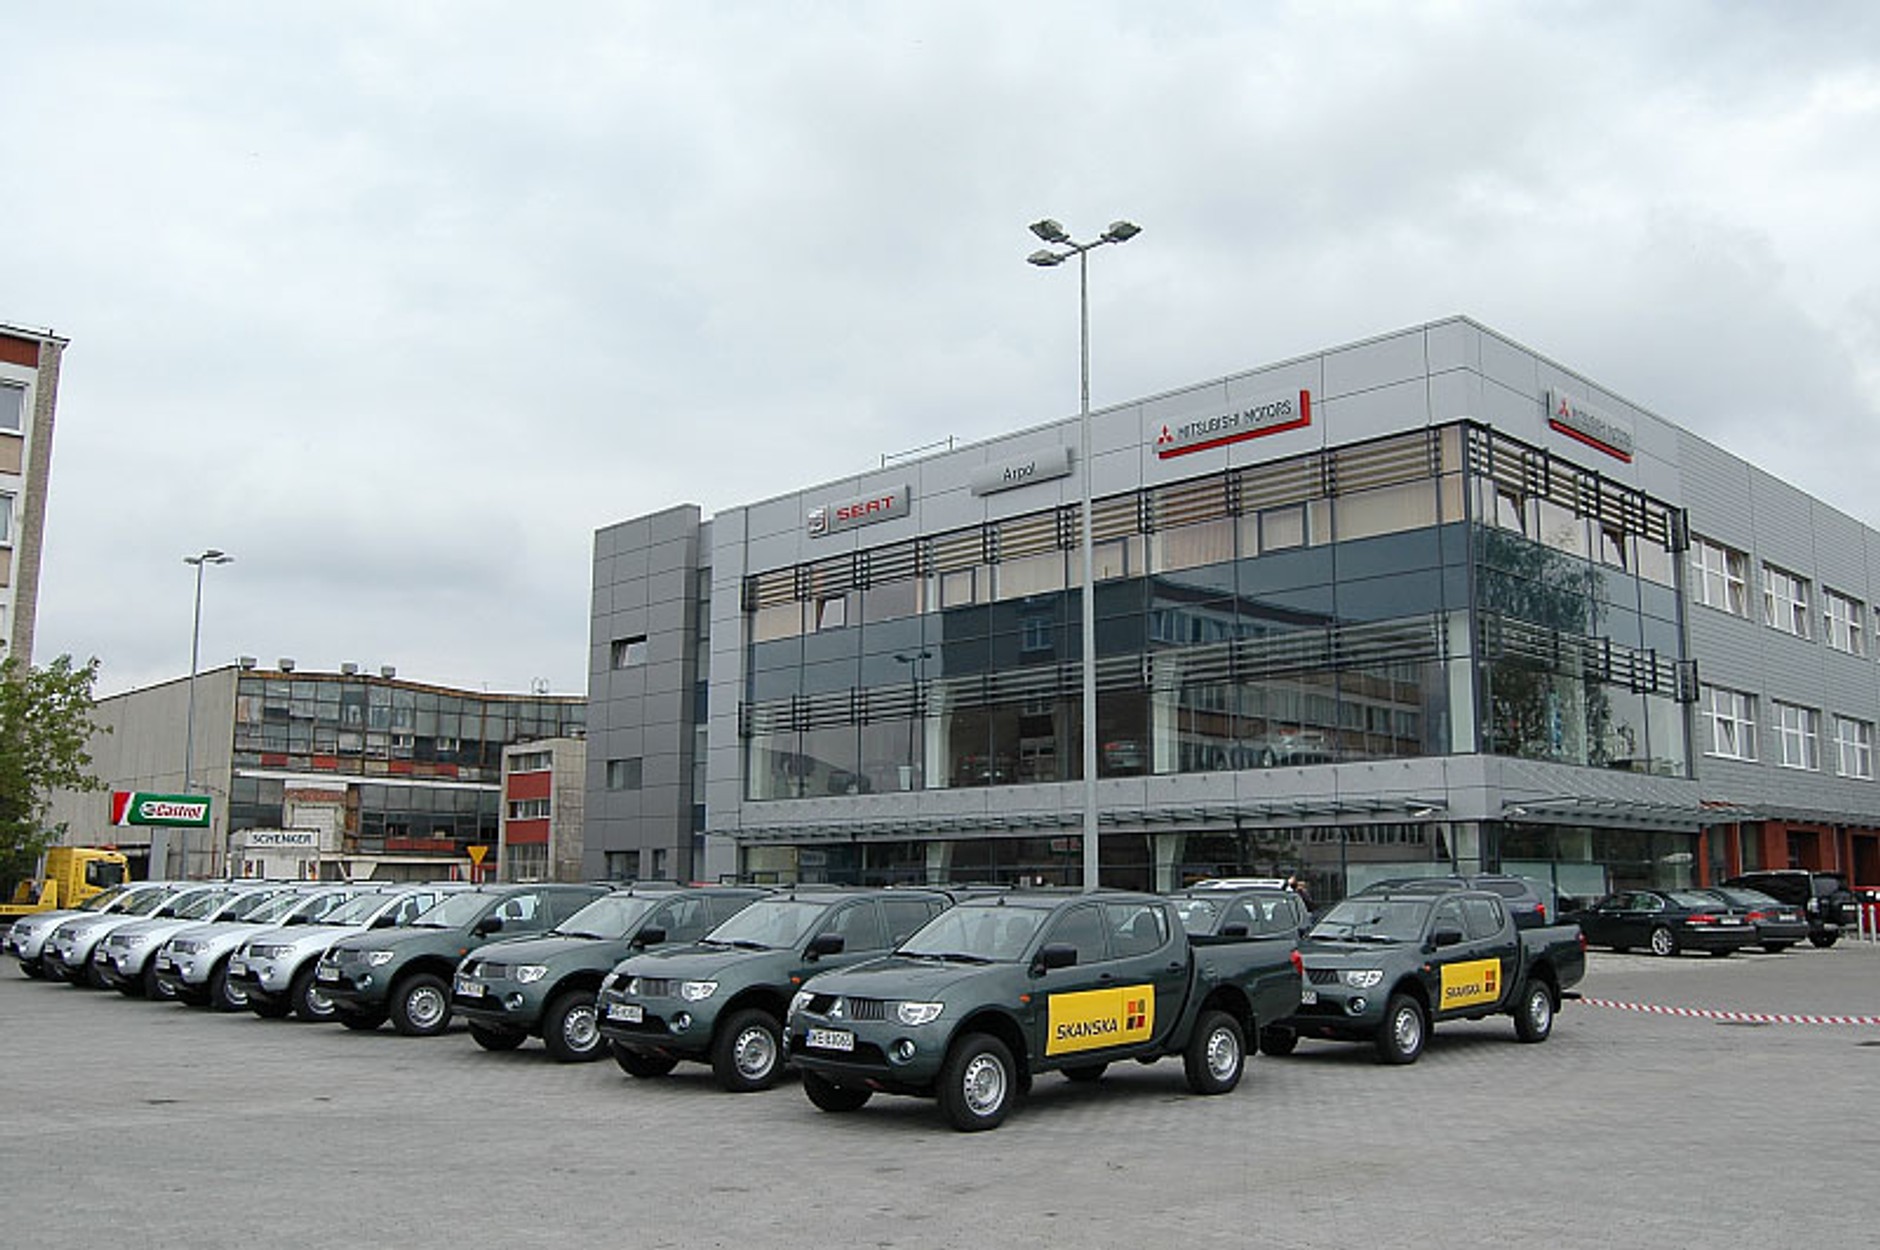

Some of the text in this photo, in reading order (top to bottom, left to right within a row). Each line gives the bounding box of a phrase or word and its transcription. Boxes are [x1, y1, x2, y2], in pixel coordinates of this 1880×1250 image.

[1178, 400, 1292, 439] MITSUBISHI MOTORS
[1003, 461, 1035, 481] Arpol
[836, 495, 895, 520] SEAT
[156, 803, 202, 819] Castrol
[253, 834, 312, 844] SCHENKER
[1056, 1017, 1118, 1040] SKANSKA
